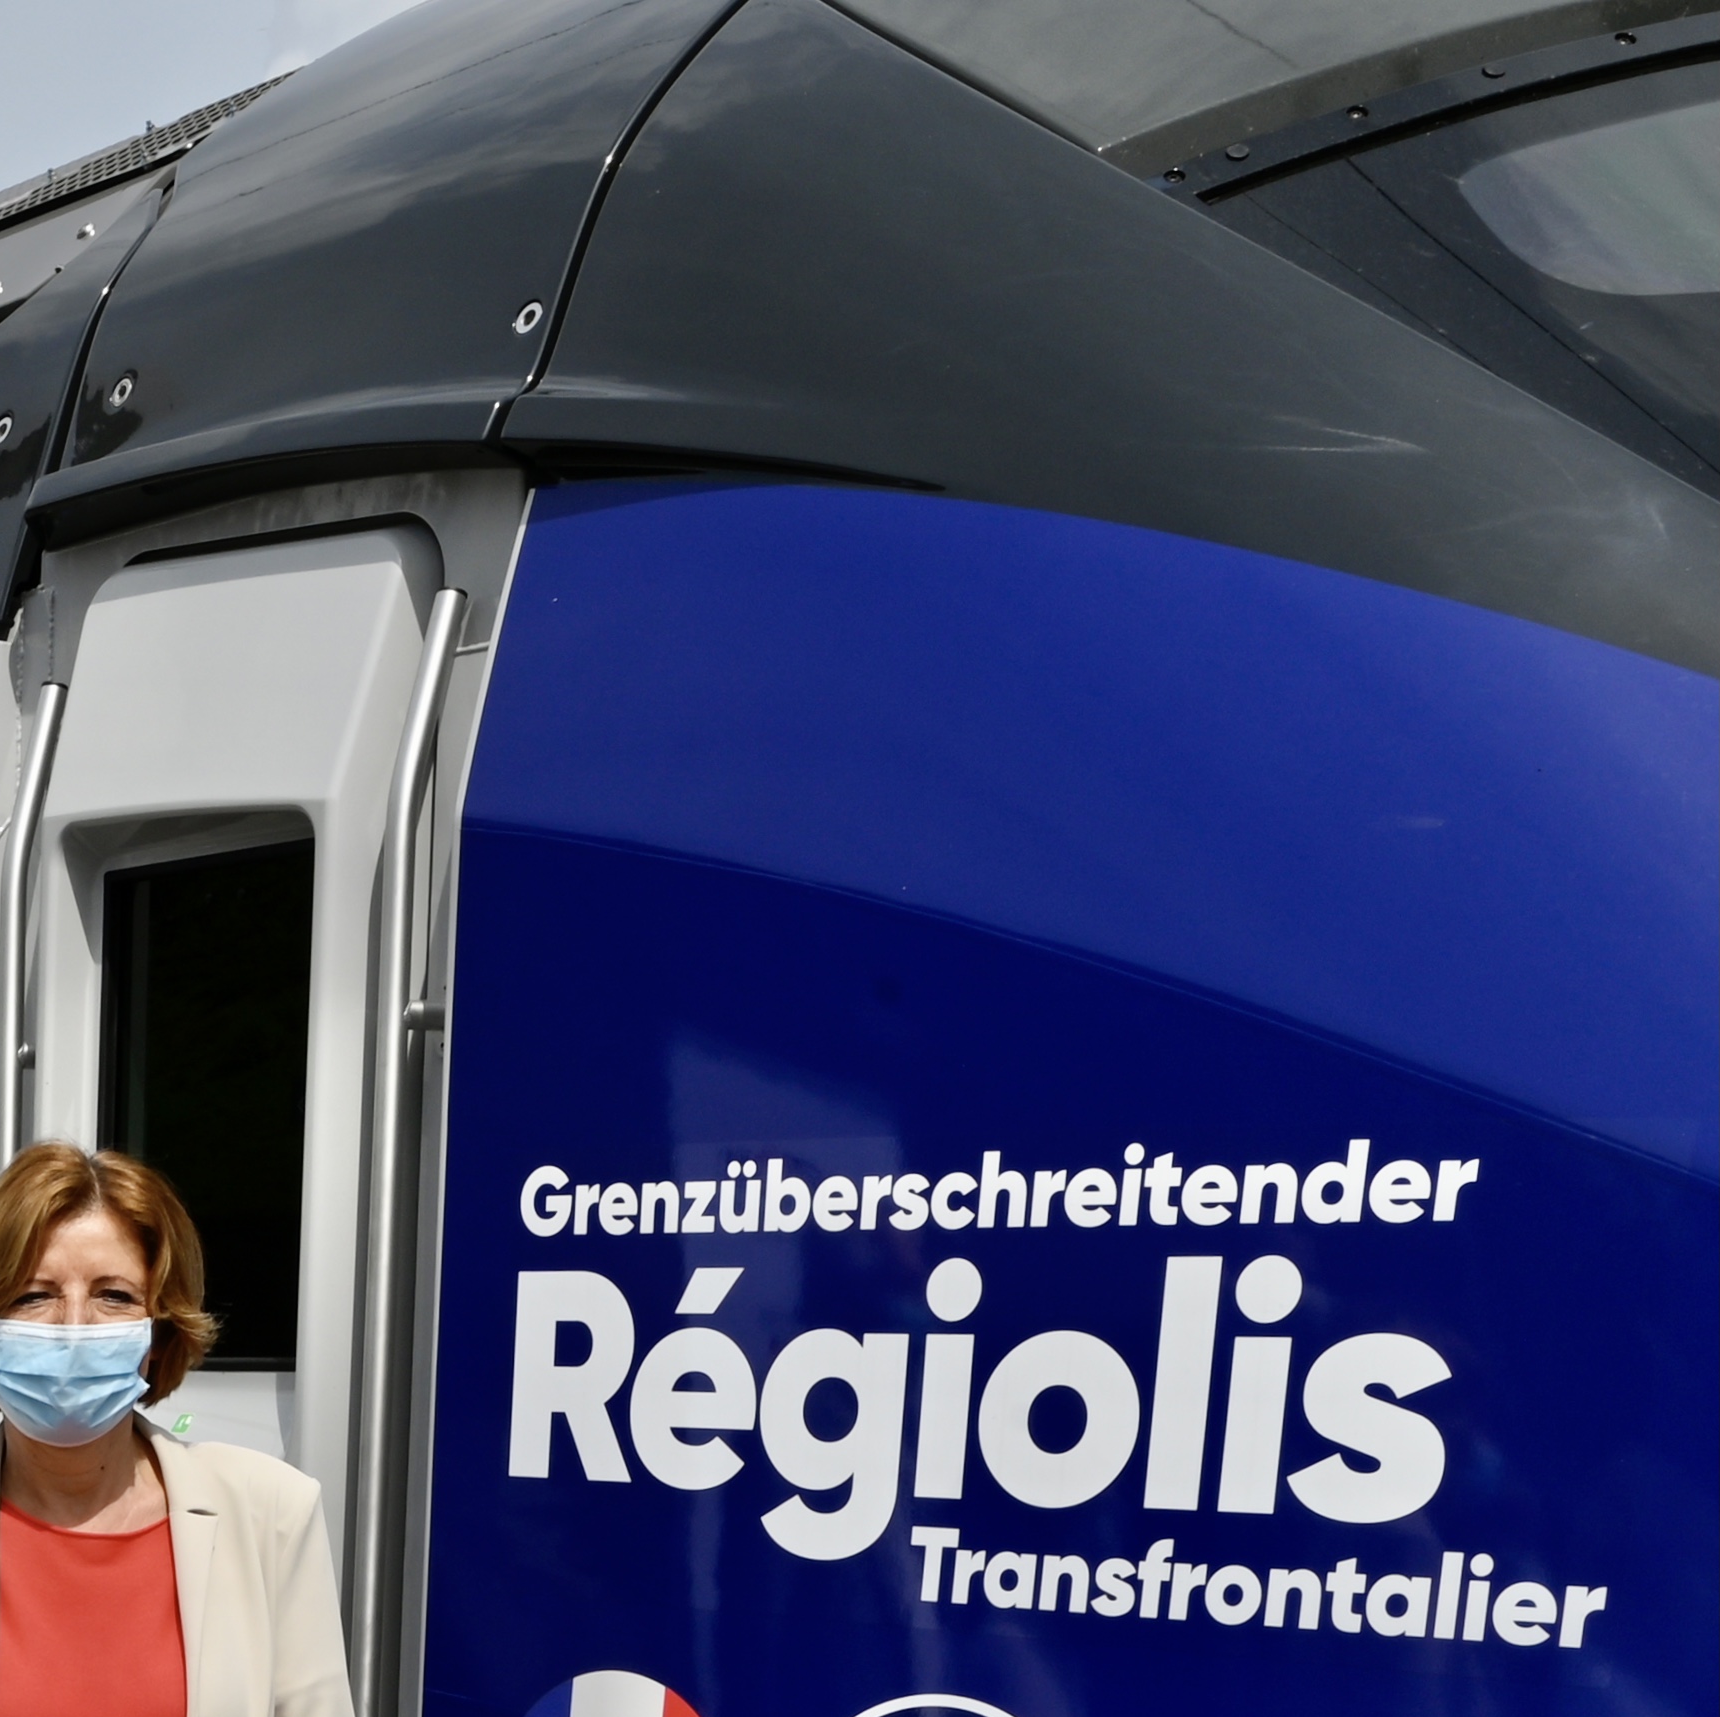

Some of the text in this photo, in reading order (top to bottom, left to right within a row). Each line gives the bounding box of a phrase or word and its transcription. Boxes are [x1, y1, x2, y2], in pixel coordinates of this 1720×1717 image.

[520, 1139, 1480, 1238] Grenzüberschreitender
[508, 1255, 1452, 1562] Régiolis
[910, 1526, 1608, 1648] Transfrontalier
